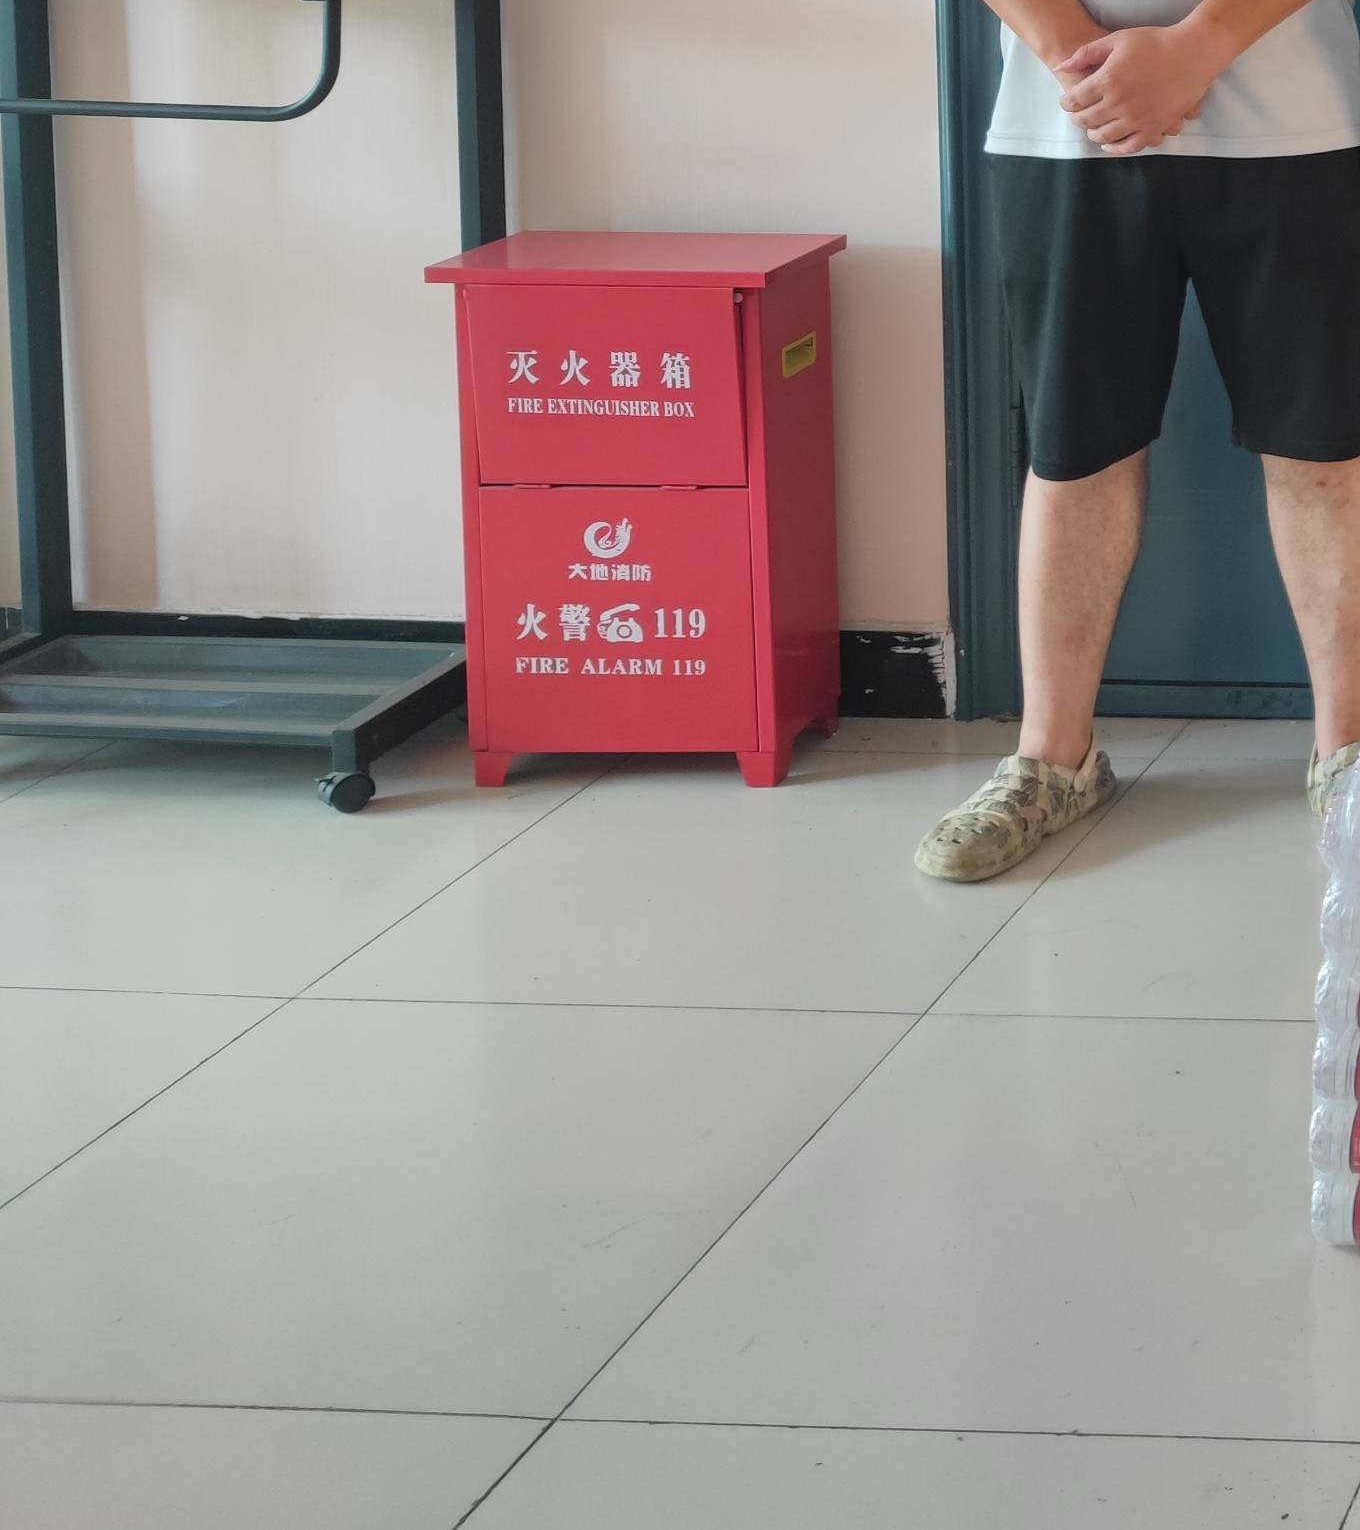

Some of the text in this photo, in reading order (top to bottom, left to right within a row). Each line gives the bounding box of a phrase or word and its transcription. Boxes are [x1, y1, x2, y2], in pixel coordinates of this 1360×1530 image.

[506, 349, 691, 389] 灭火器箱
[507, 397, 695, 418] FIRE EXTINGUISHER BOX
[567, 562, 652, 582] 大地消防
[516, 603, 706, 642] 火警 119
[515, 656, 706, 676] FIRE ALARM 119
